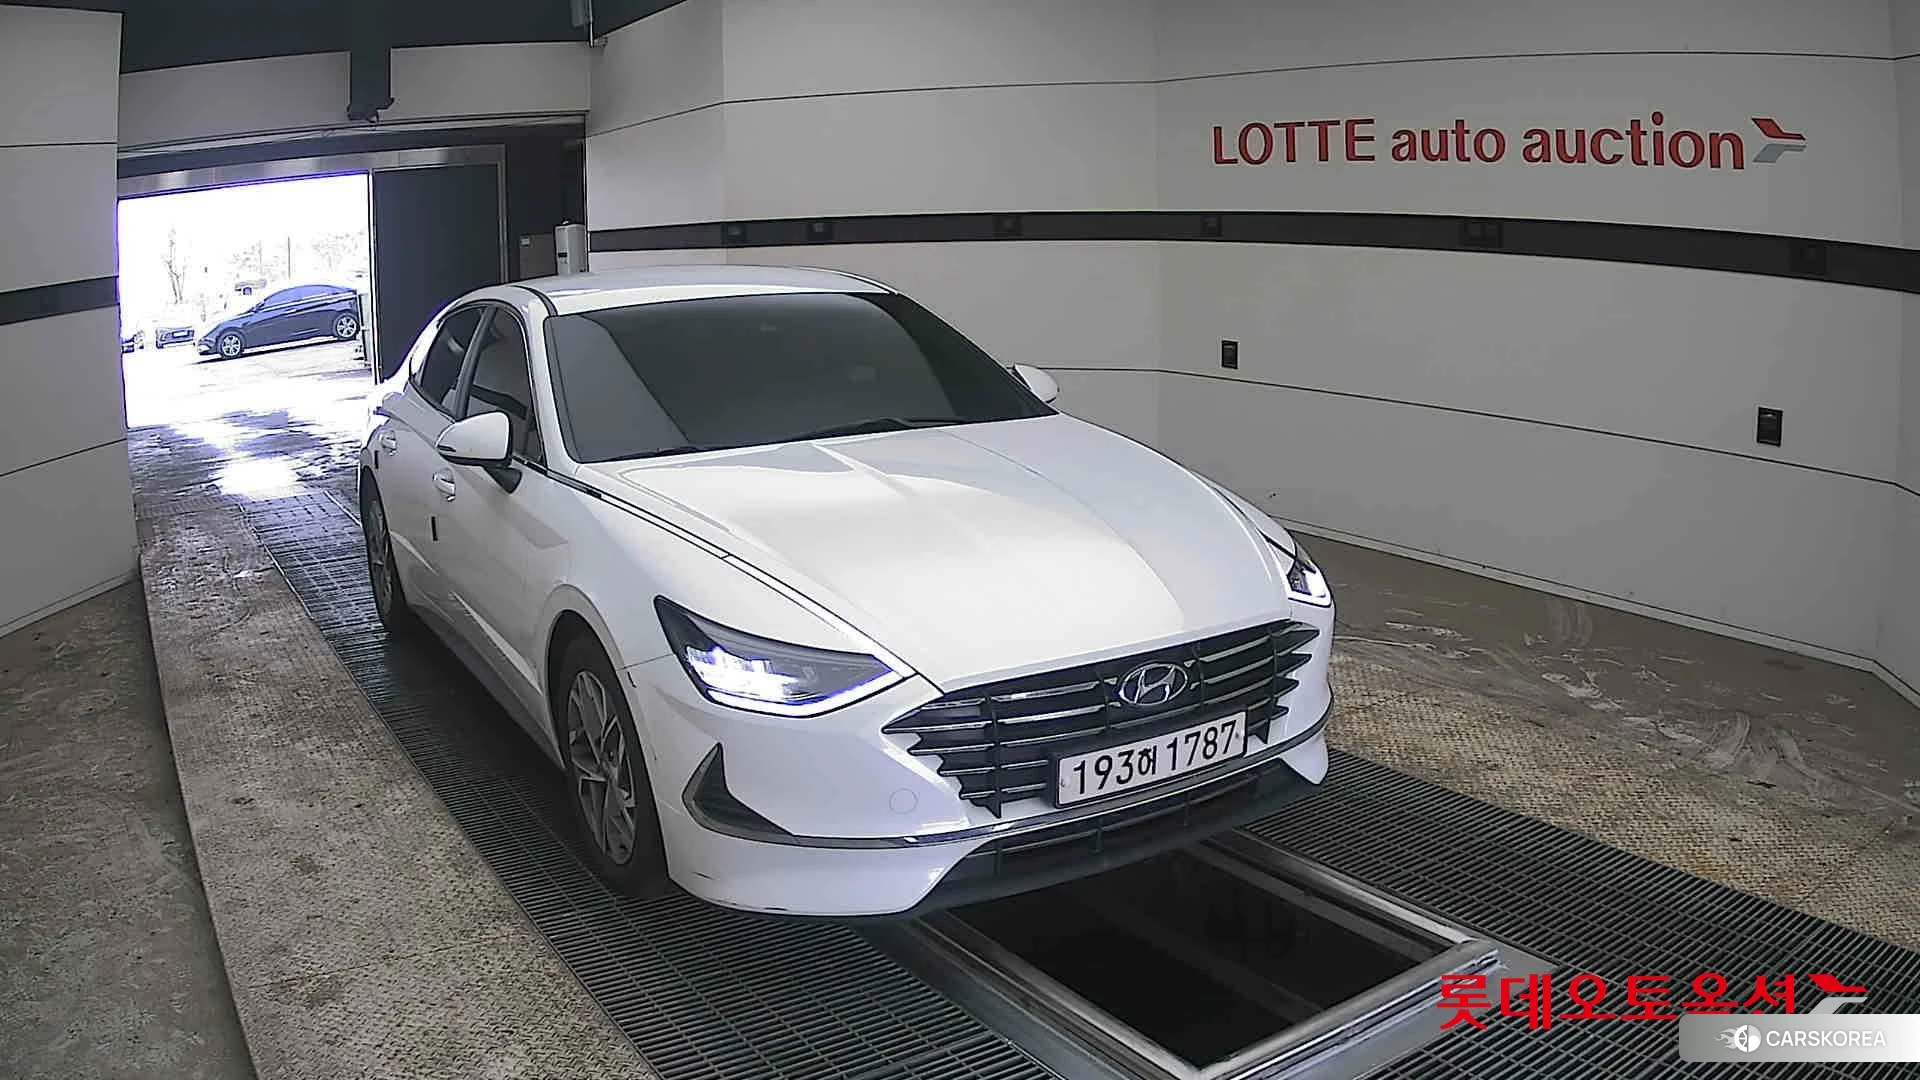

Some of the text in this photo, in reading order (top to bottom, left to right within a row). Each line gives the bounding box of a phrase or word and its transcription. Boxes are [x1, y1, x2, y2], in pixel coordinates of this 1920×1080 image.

[1212, 112, 1745, 169] LOTTE auto auction
[1073, 719, 1238, 795] 193허 1787
